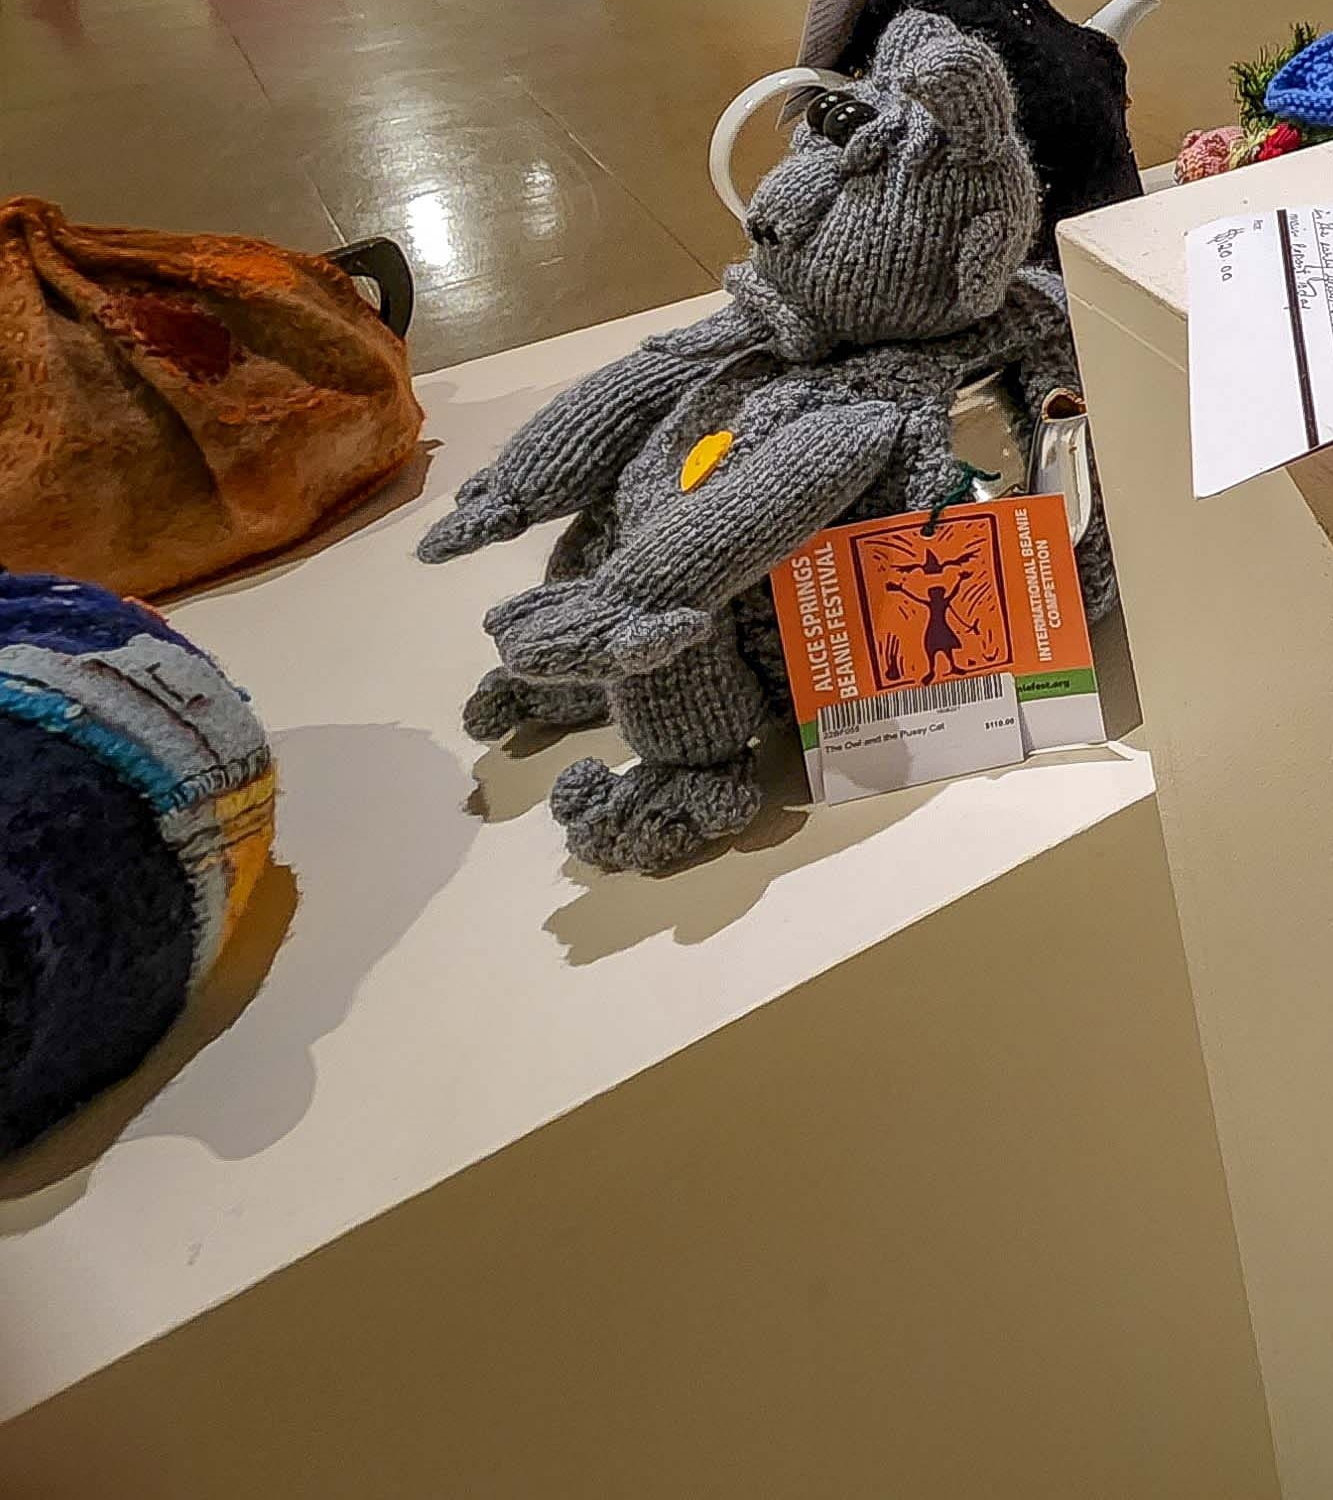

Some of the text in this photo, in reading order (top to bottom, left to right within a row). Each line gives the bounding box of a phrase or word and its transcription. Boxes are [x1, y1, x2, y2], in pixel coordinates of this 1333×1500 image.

[791, 555, 834, 692] ALICE SPRINGS
[815, 541, 858, 699] BEANIE FESTIVAL
[1015, 507, 1052, 662] INTERNATIONAL BEANIE
[1035, 539, 1061, 628] COMPETITION
[825, 722, 946, 755] The Owl and the Pussy Cat
